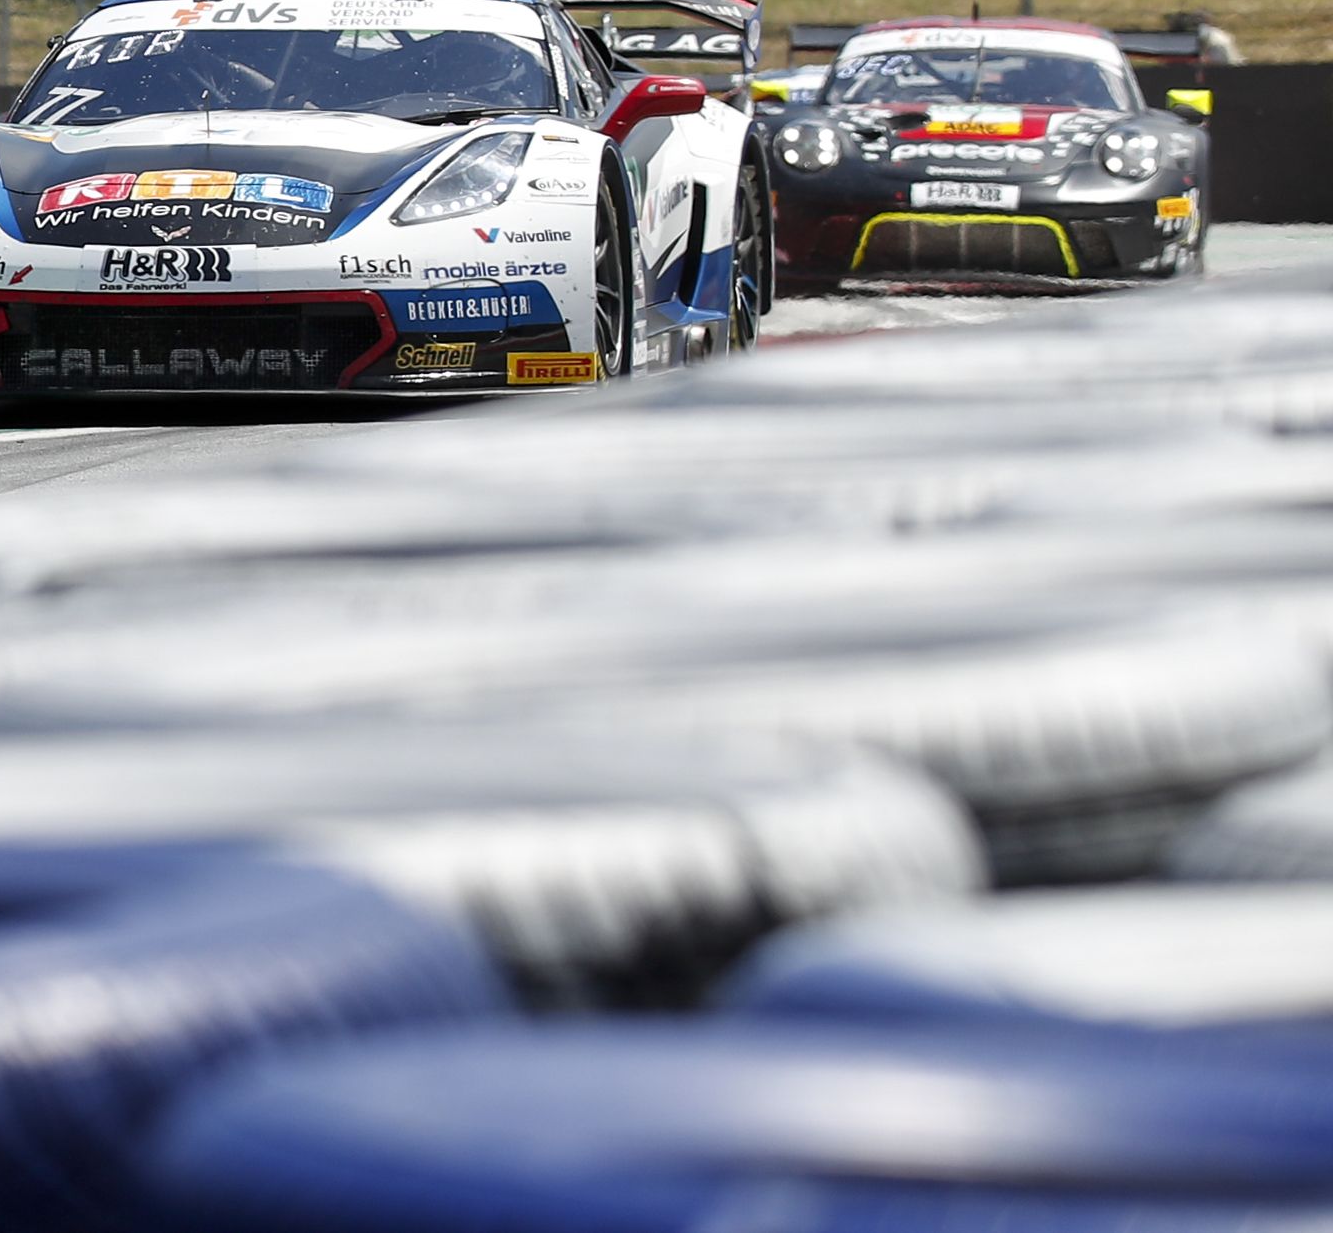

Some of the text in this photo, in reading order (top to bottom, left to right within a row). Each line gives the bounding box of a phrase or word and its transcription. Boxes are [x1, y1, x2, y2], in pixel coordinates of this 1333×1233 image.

[212, 2, 298, 24] dvs
[330, 9, 414, 17] VERSAND
[332, 0, 434, 9] DEUTSCHER
[328, 17, 403, 26] SERVICE
[19, 86, 106, 126] 77
[890, 143, 1045, 163] precote
[55, 171, 308, 207] RTL
[34, 201, 327, 230] Wir helfen Kindern
[503, 229, 572, 244] Valvoline
[102, 248, 185, 280] H&R
[339, 254, 412, 274] f1s.ch
[423, 260, 568, 280] mobile ärzte
[99, 283, 187, 291] Das Fahrwerk!
[407, 295, 528, 321] BECKER&HÜSER
[20, 348, 329, 376] CALLAWAY
[396, 342, 476, 368] Schnell
[516, 358, 592, 378] PIRELLI
